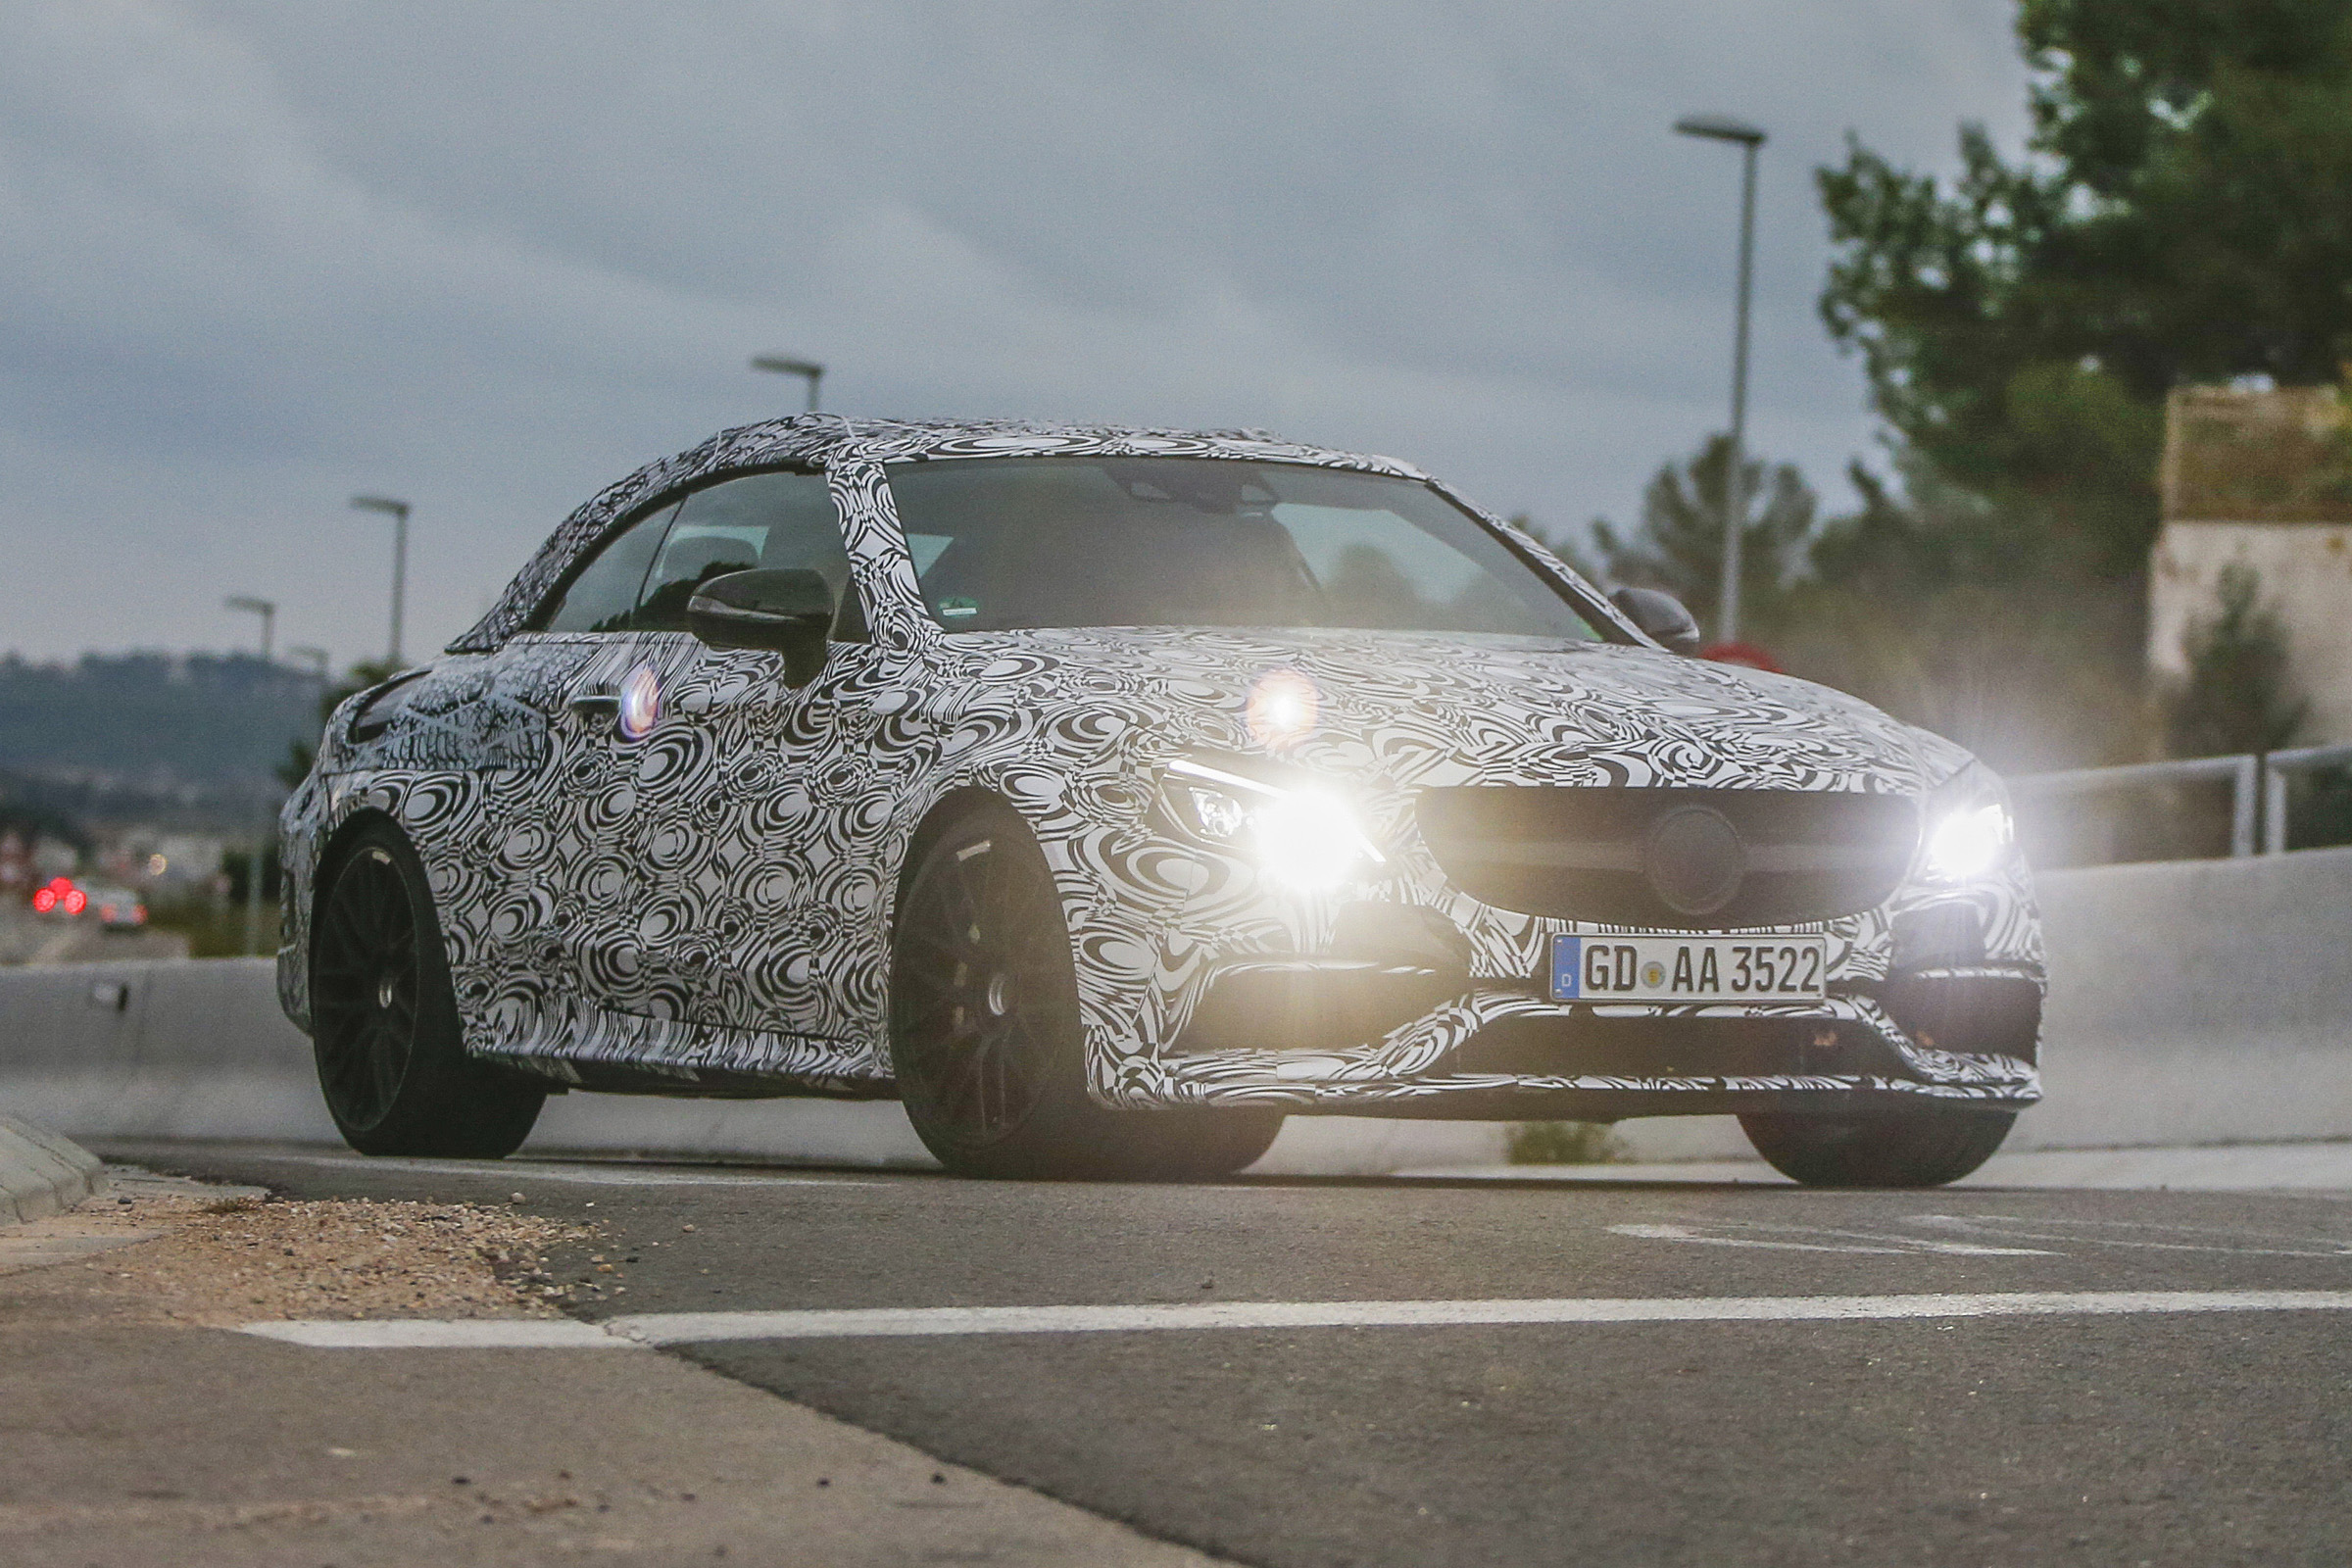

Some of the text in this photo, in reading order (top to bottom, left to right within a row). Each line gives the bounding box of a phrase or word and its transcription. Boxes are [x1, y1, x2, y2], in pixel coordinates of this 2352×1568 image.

[1561, 973, 1572, 987] D
[1585, 945, 1821, 992] GD AA 3522
